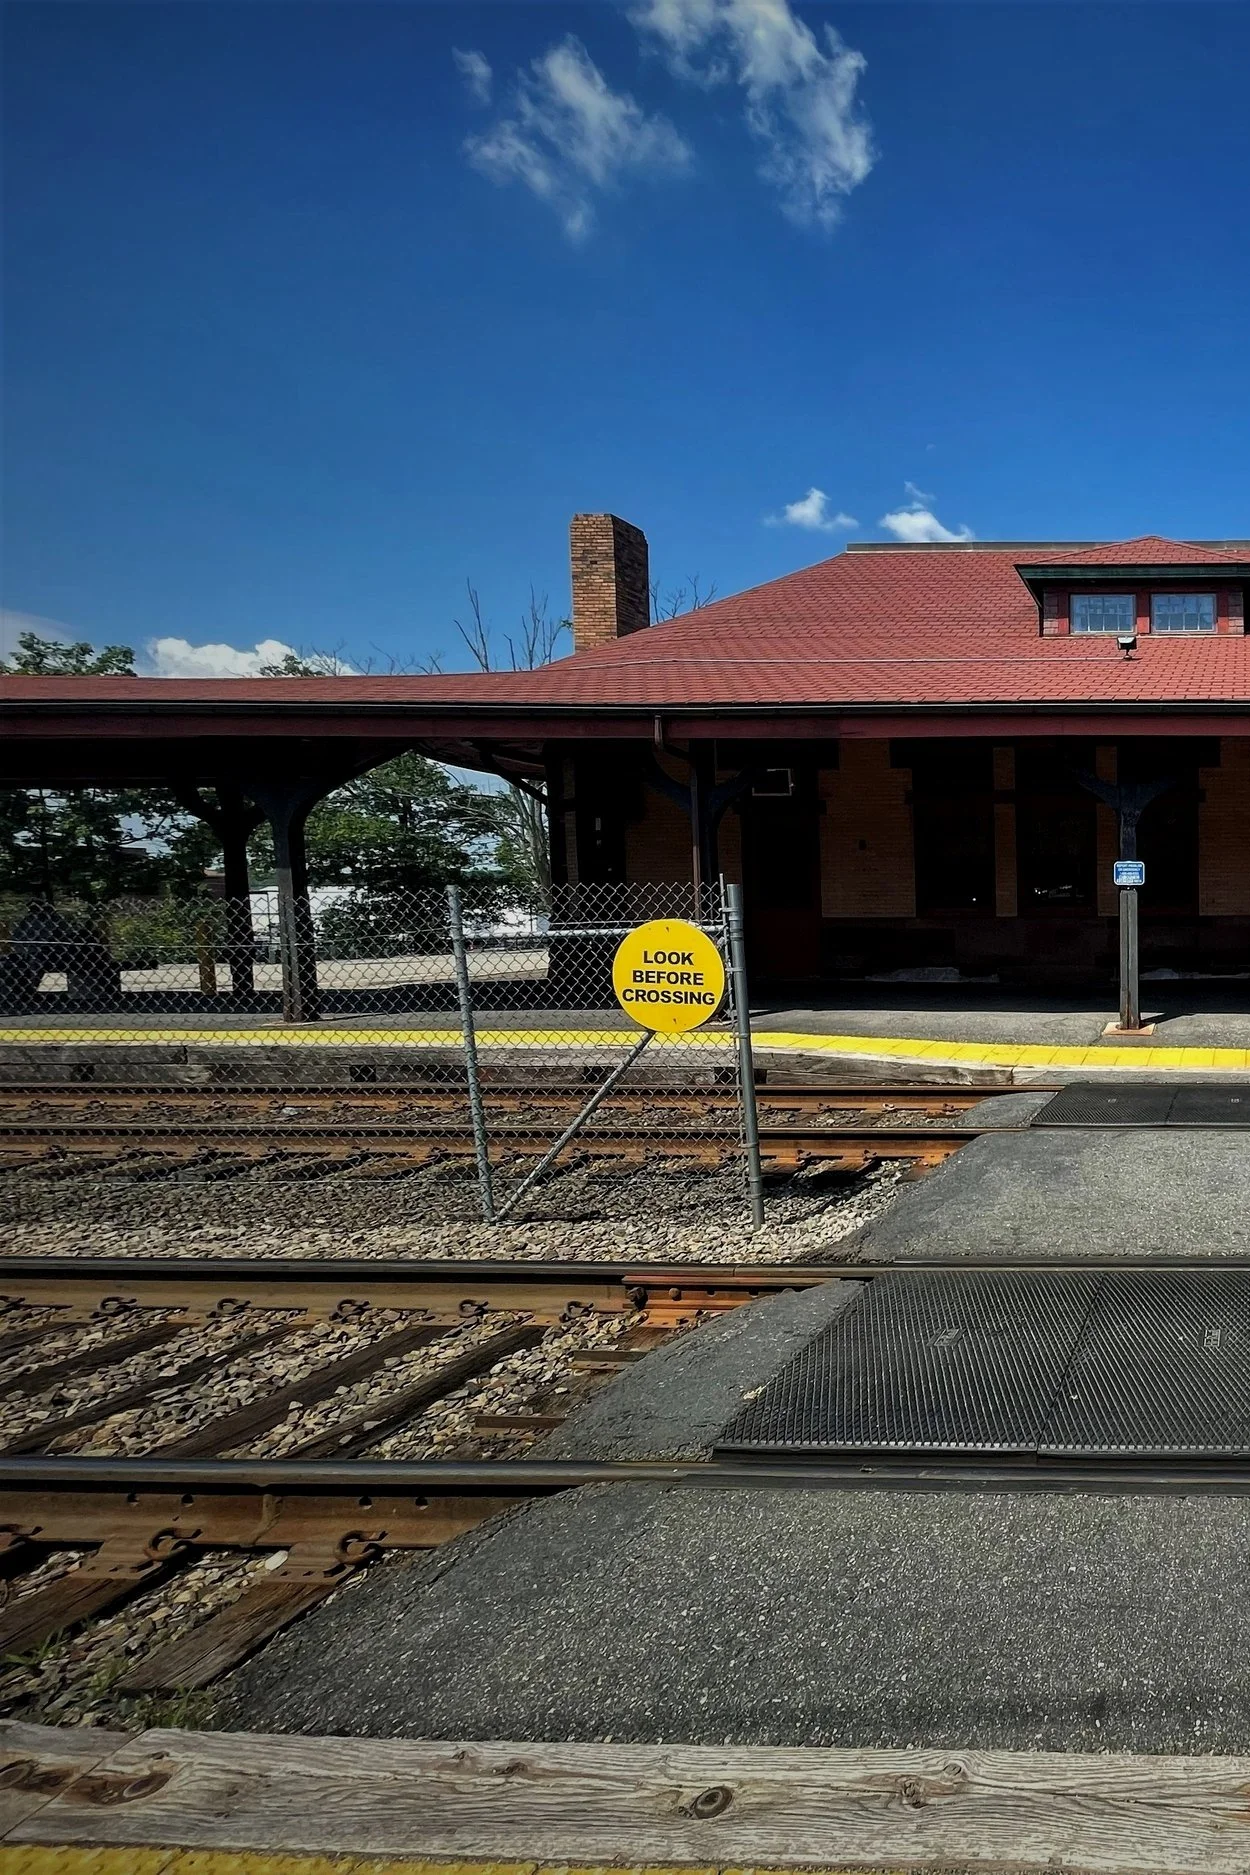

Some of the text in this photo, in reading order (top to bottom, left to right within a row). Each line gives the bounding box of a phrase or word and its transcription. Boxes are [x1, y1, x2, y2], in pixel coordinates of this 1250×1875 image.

[643, 950, 694, 966] LOOK
[632, 970, 704, 985] BEFORE
[622, 988, 715, 1005] CROSSING
